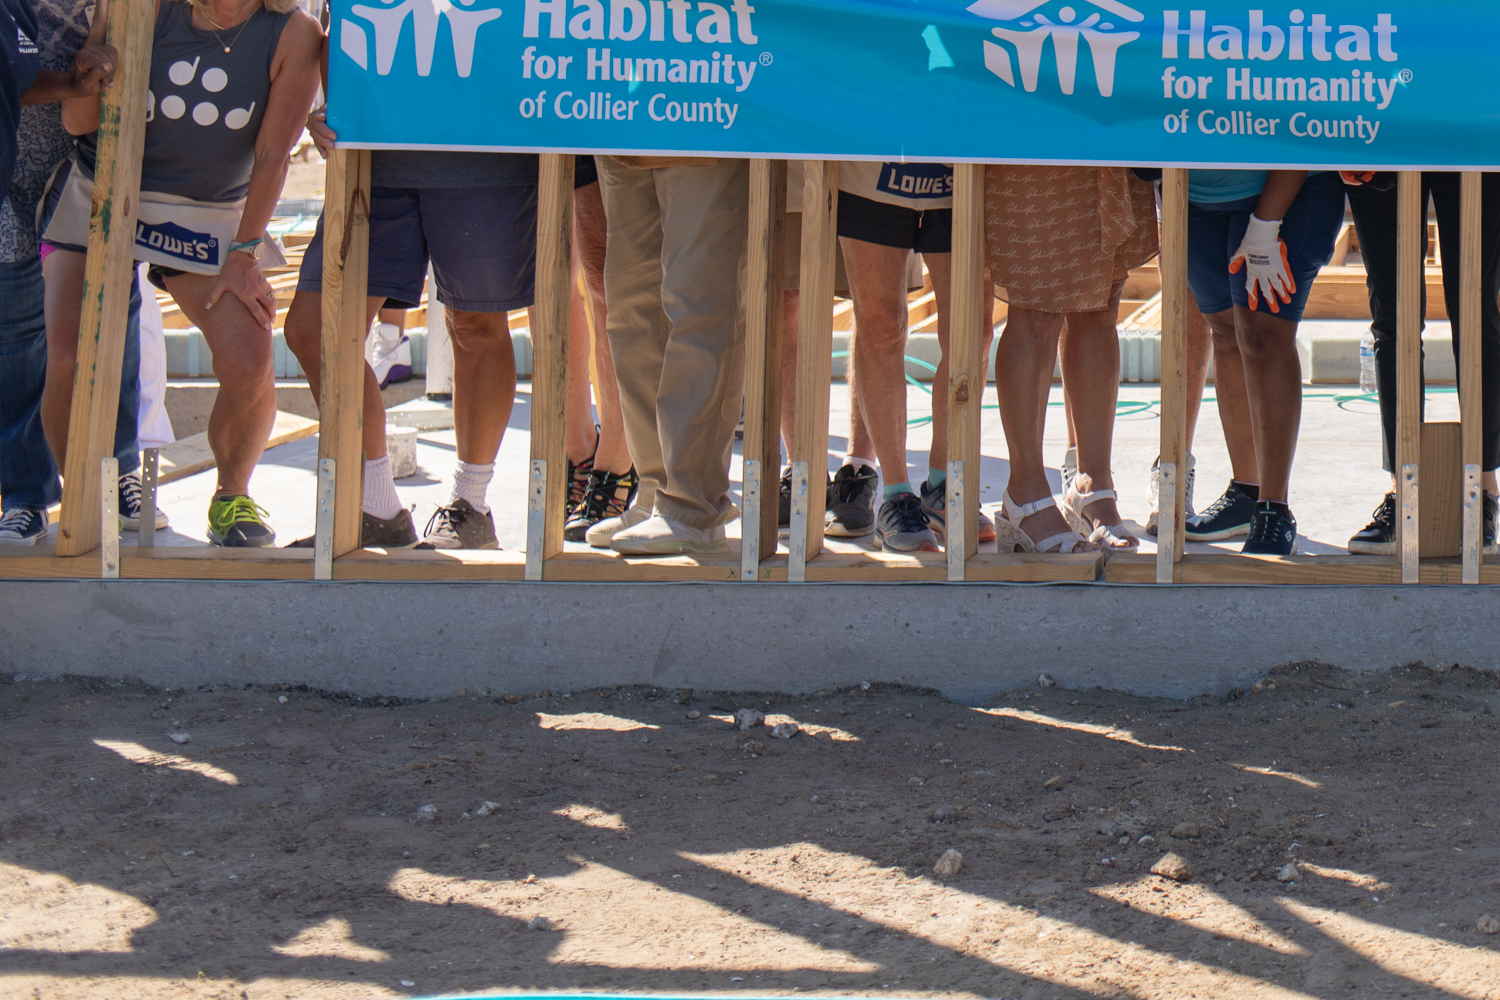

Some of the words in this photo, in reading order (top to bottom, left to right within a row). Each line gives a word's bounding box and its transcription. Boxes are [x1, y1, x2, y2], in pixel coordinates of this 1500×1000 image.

[1162, 9, 1398, 62] Habitat
[521, 46, 573, 80] for
[1162, 67, 1213, 100] for
[520, 91, 547, 119] of
[554, 92, 640, 121] Collier
[648, 94, 739, 130] County
[1164, 109, 1189, 134] of
[1198, 110, 1280, 136] Collier
[1290, 113, 1380, 144] County
